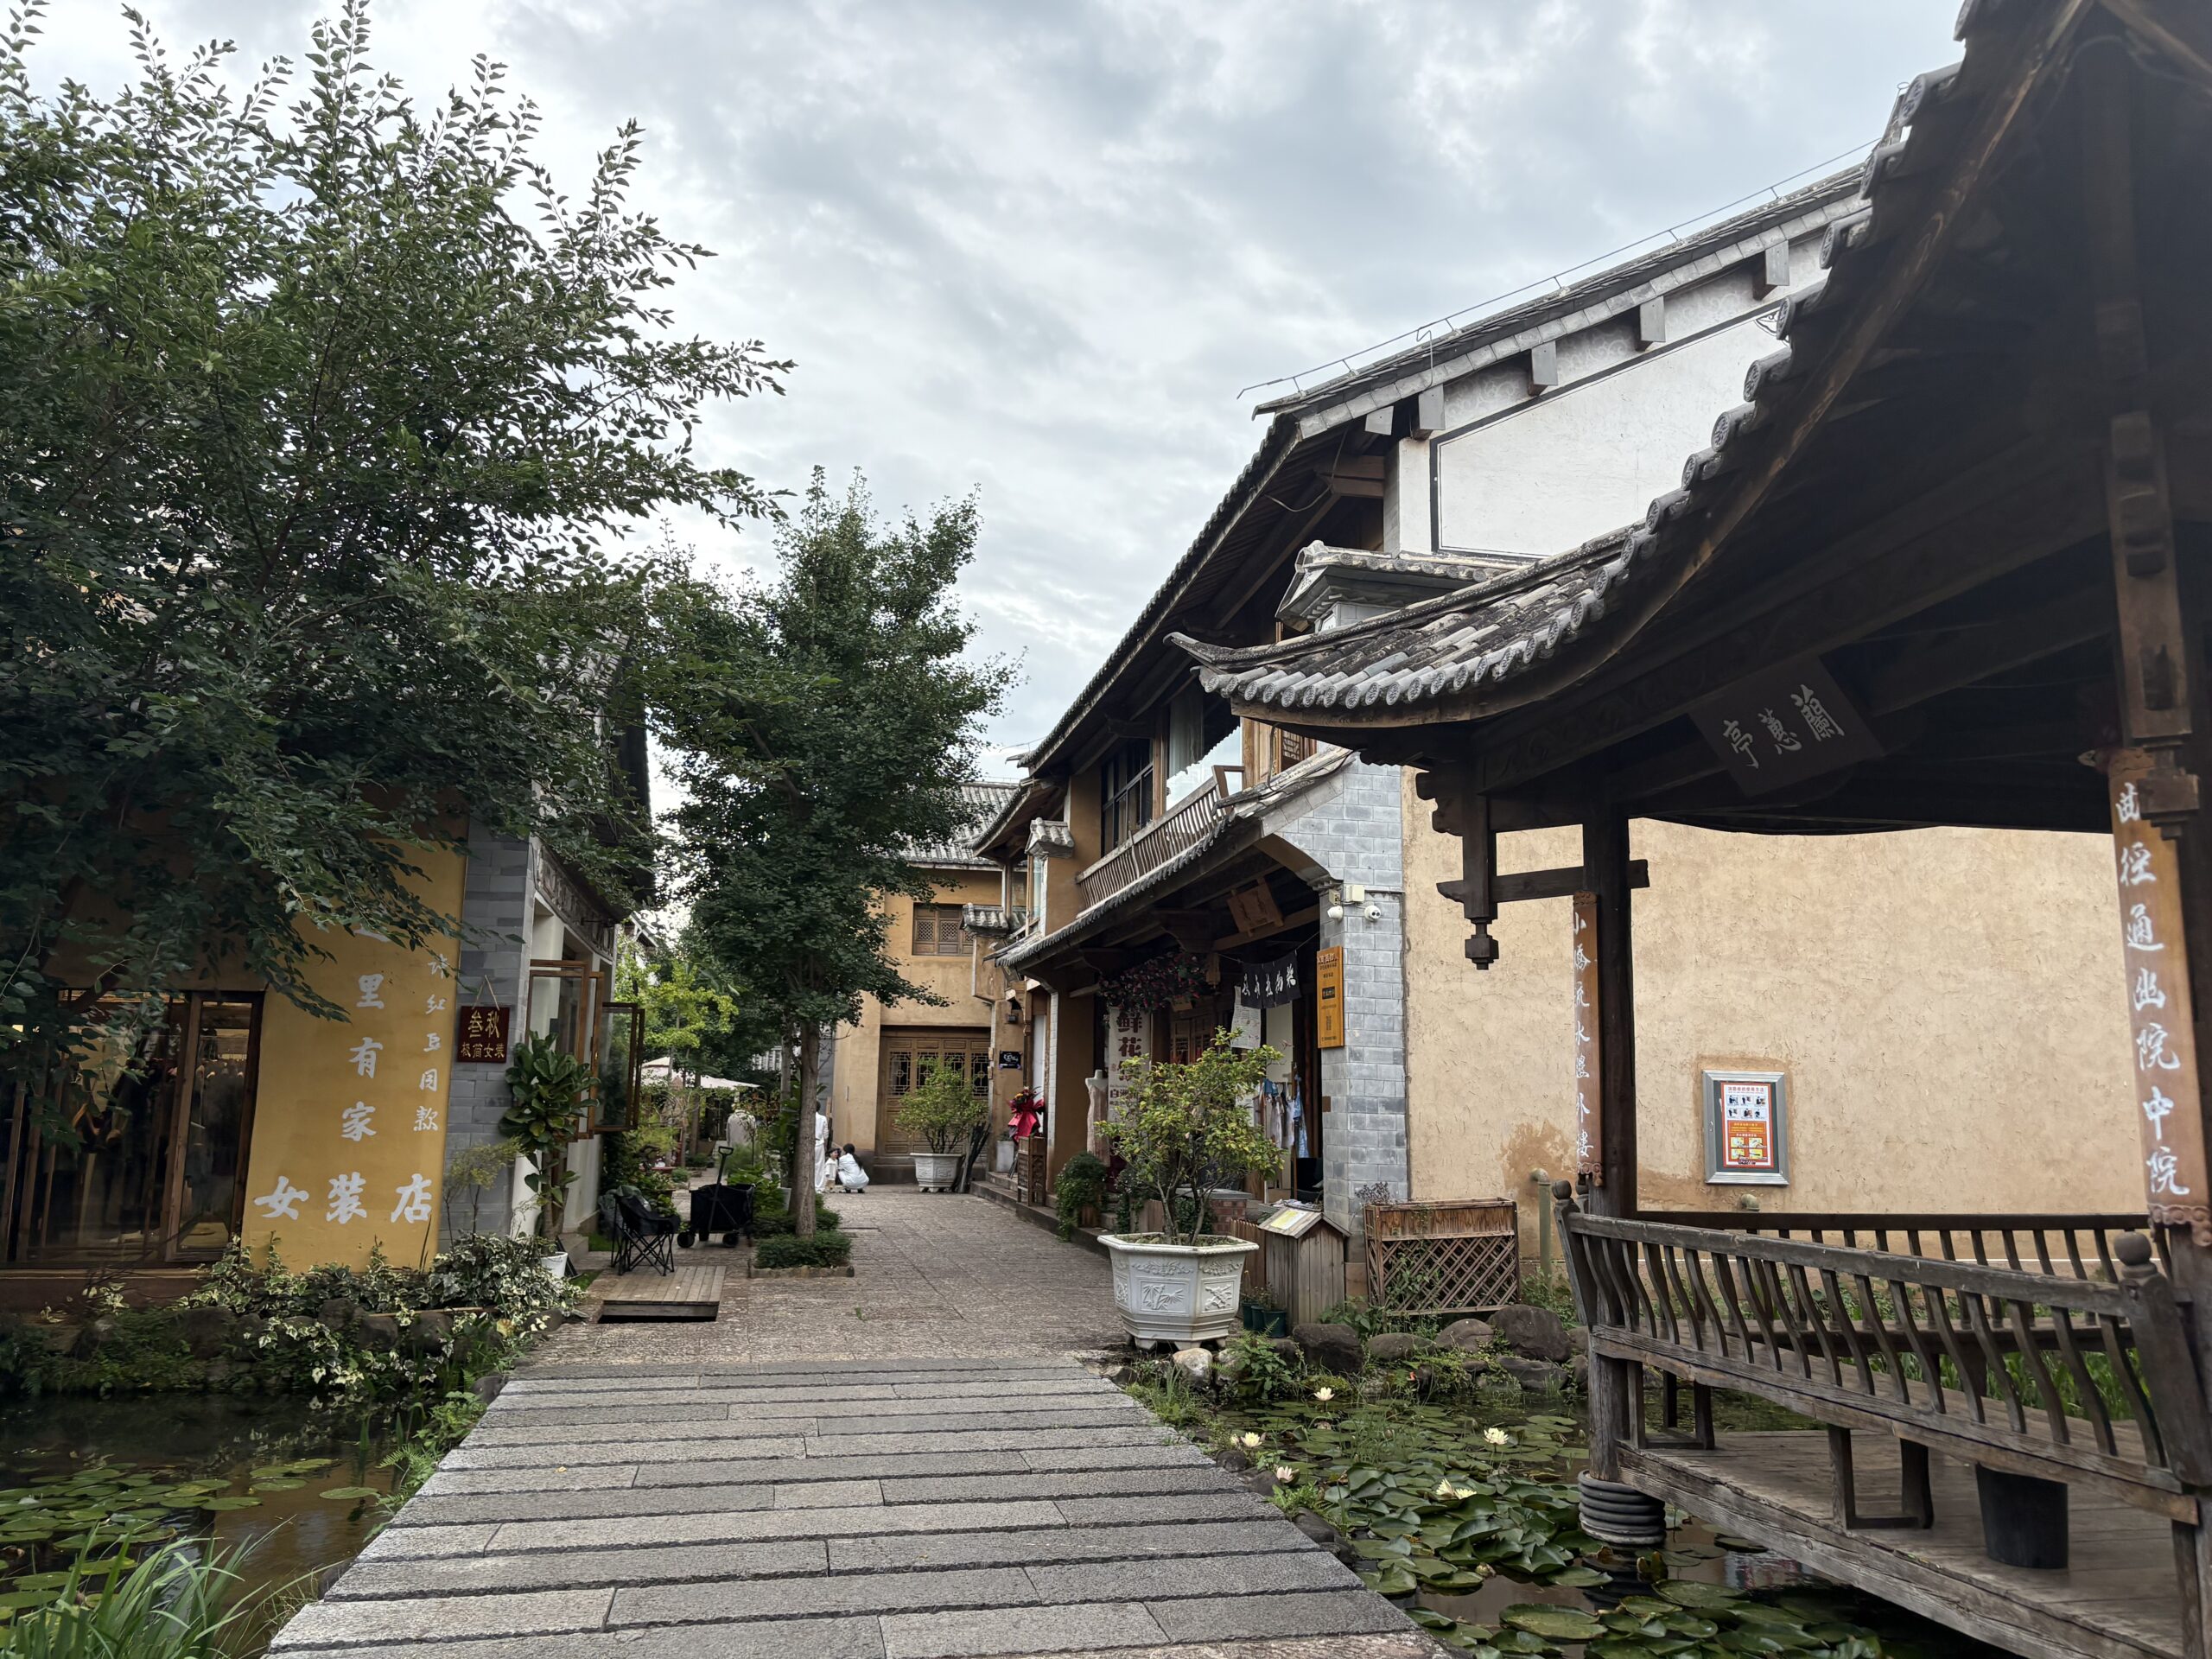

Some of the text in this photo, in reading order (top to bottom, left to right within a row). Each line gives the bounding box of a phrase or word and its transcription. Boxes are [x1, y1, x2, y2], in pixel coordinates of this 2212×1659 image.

[341, 927, 391, 1141] 里有家
[254, 1172, 433, 1224] 女装店
